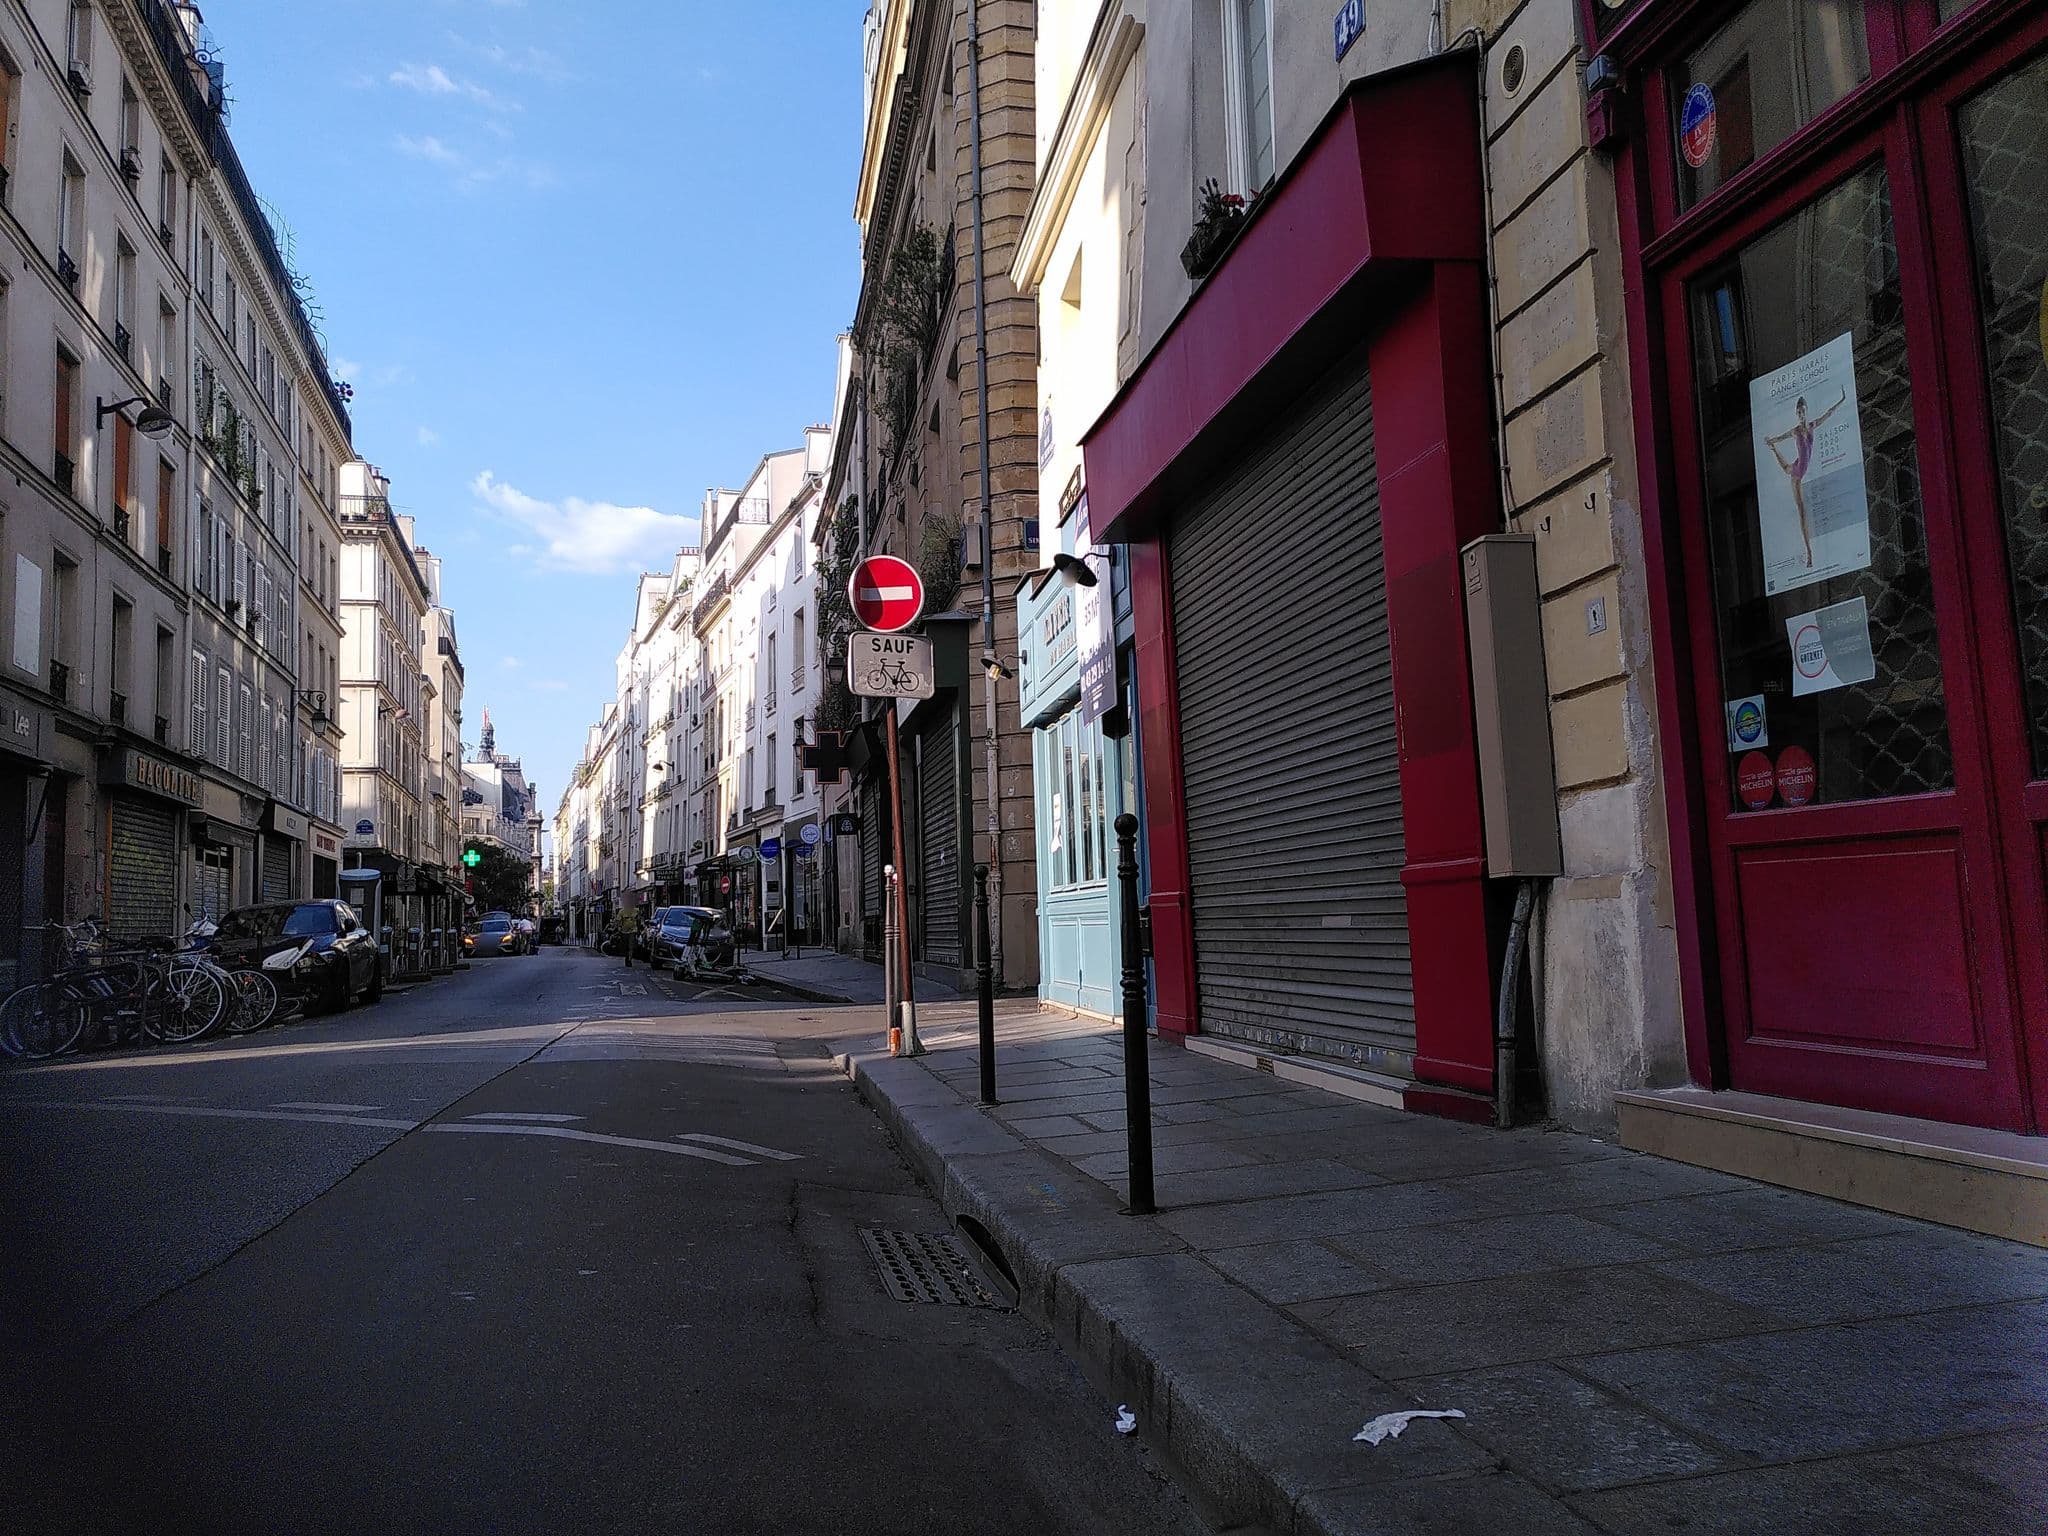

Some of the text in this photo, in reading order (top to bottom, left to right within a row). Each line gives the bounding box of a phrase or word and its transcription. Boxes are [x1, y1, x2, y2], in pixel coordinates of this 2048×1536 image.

[1339, 0, 1358, 46] 49
[1771, 352, 1829, 386] PARIS MARAIS
[1771, 382, 1797, 397] DANCE
[1799, 363, 1829, 384] SCHOOL
[1819, 422, 1850, 441] SAISON
[872, 638, 915, 654] SAUF
[1740, 778, 1773, 792] MICHELIN
[1778, 774, 1814, 787] MICHELIN
